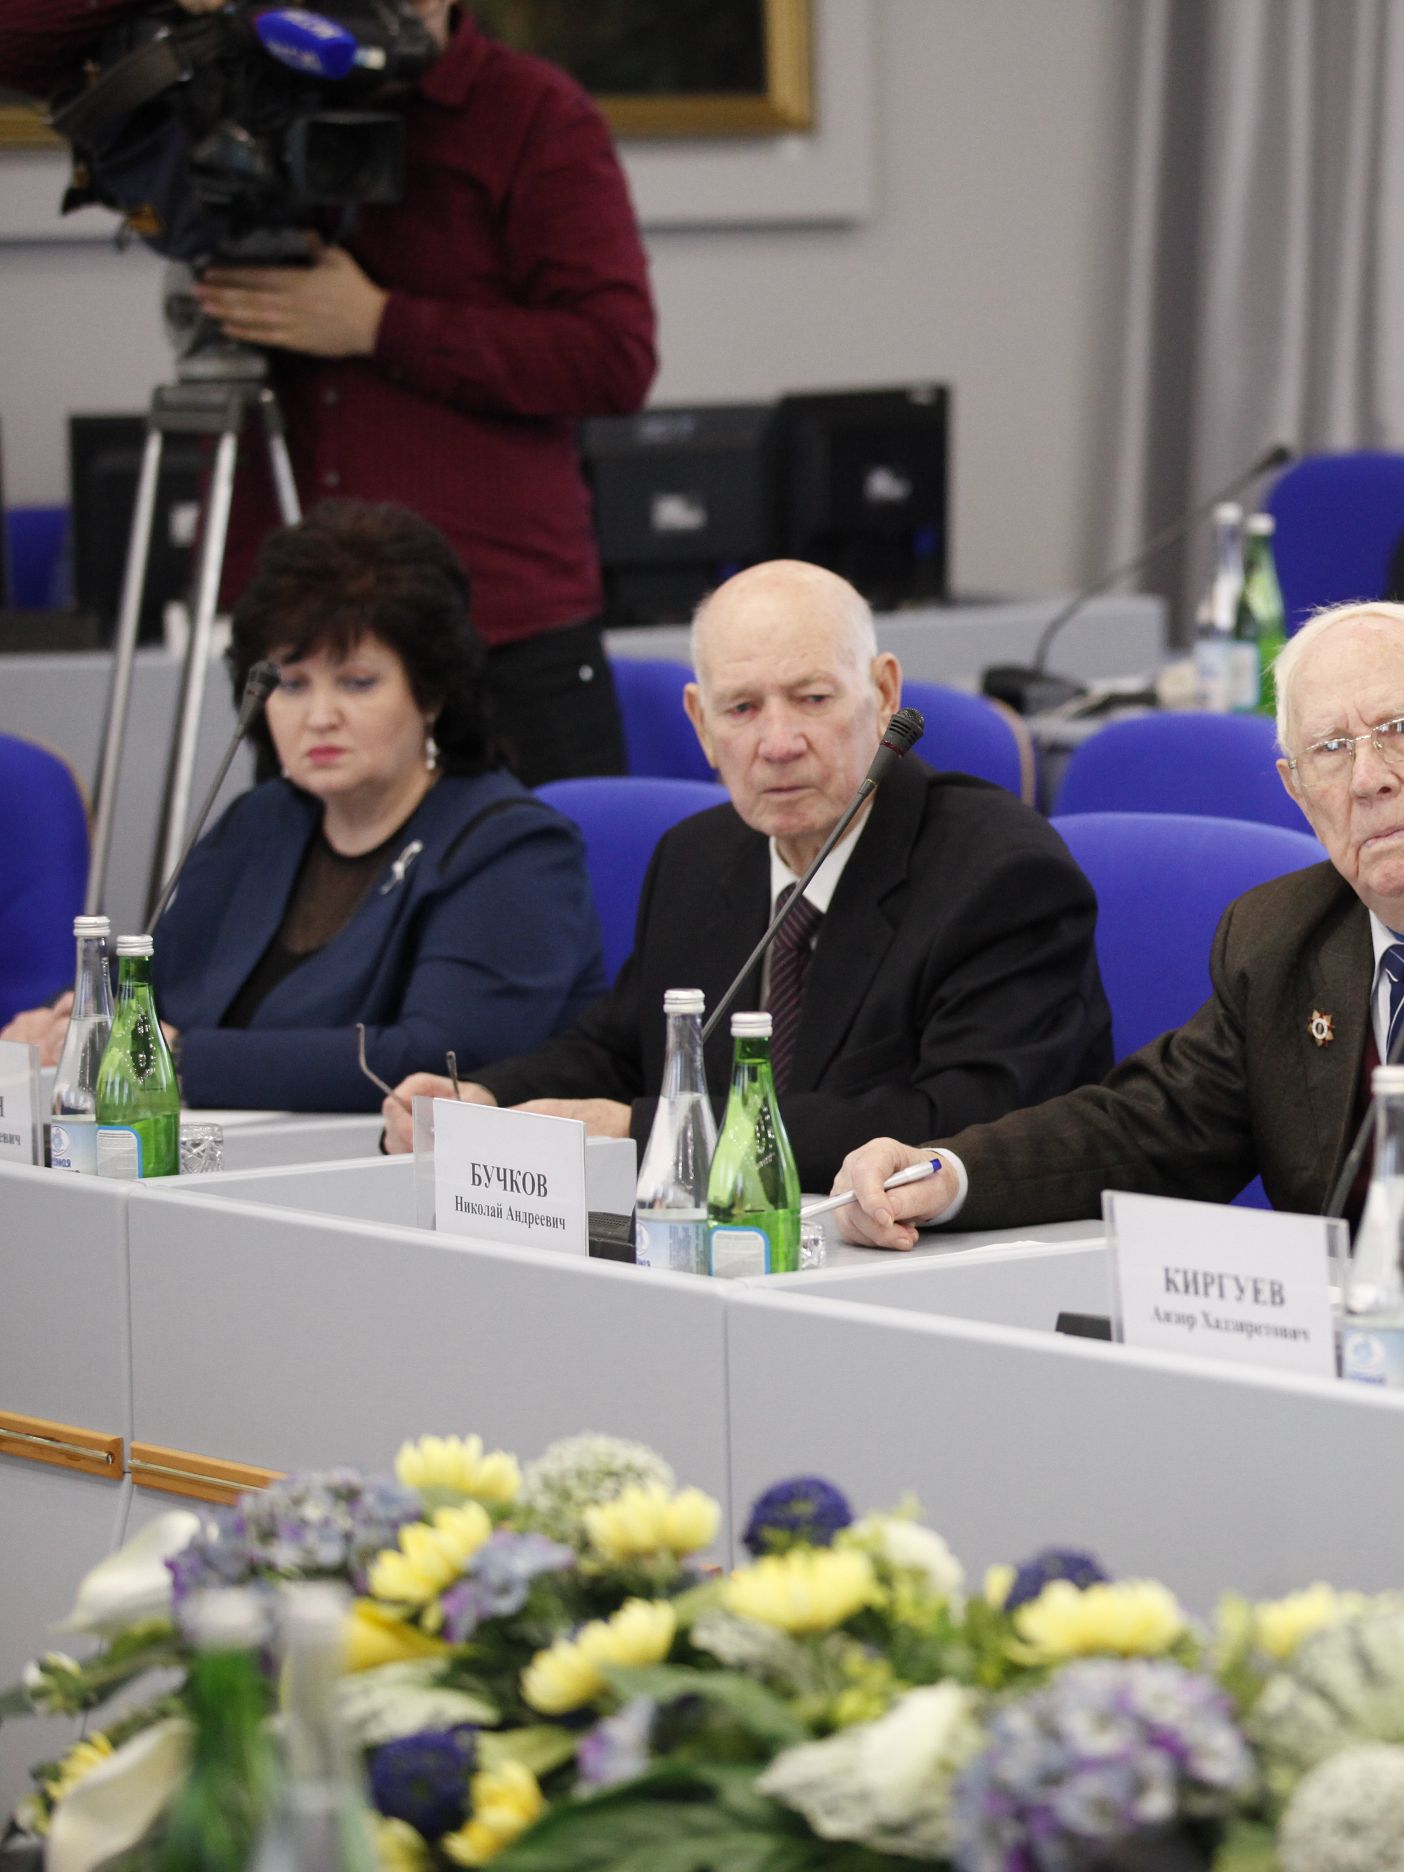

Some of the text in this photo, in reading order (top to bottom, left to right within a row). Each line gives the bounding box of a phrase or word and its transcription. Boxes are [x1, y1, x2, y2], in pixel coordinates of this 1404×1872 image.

[471, 1162, 548, 1198] БУЧКОВ
[455, 1195, 566, 1230] Николай Андреевич
[1163, 1266, 1286, 1307] КИРГУЕВ
